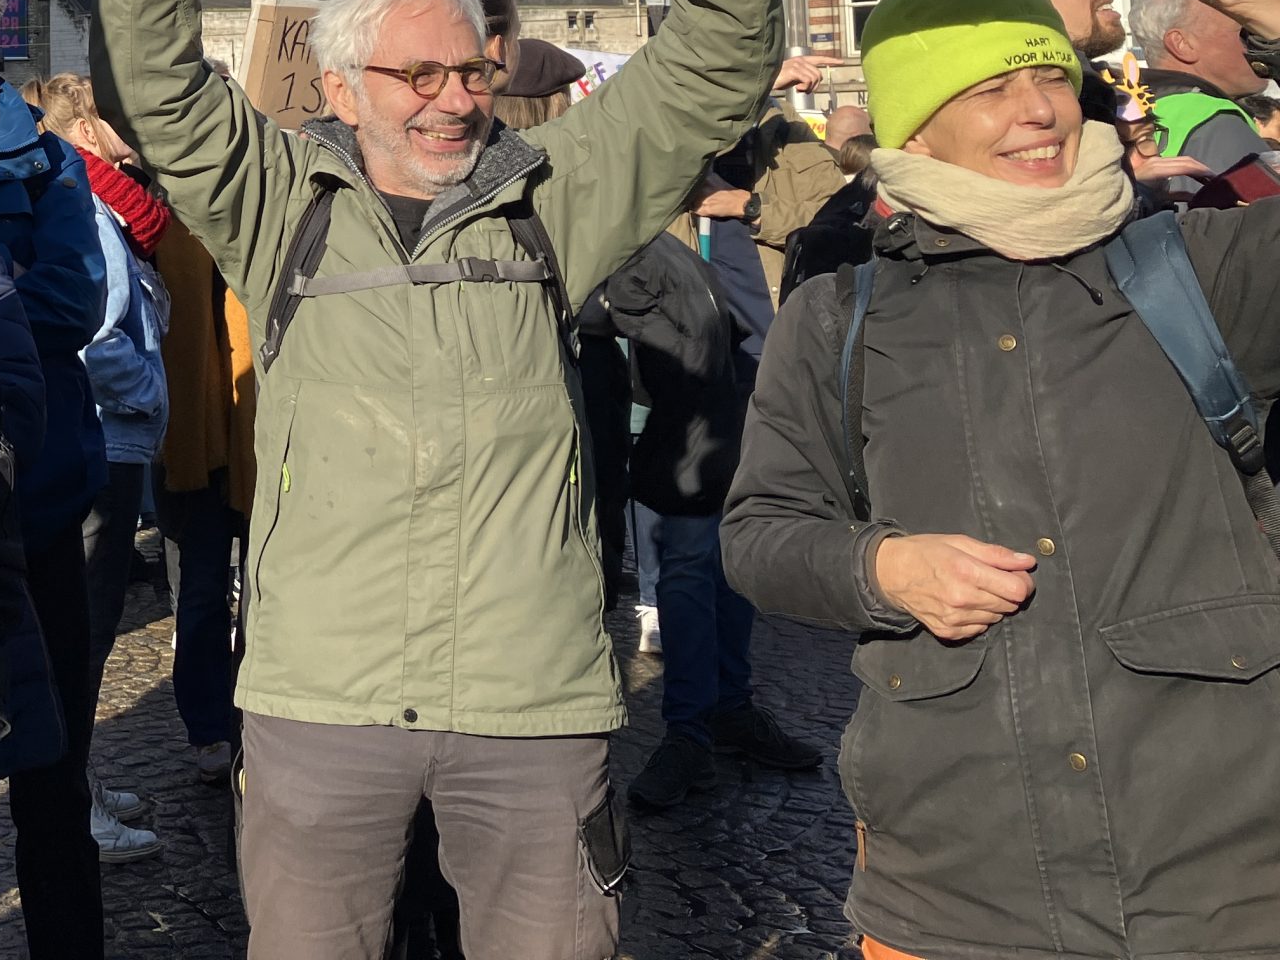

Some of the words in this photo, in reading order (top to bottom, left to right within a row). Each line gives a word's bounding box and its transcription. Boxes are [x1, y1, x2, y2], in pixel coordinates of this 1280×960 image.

[277, 15, 312, 64] KA
[1025, 37, 1050, 48] HART
[1004, 52, 1037, 66] VOOR
